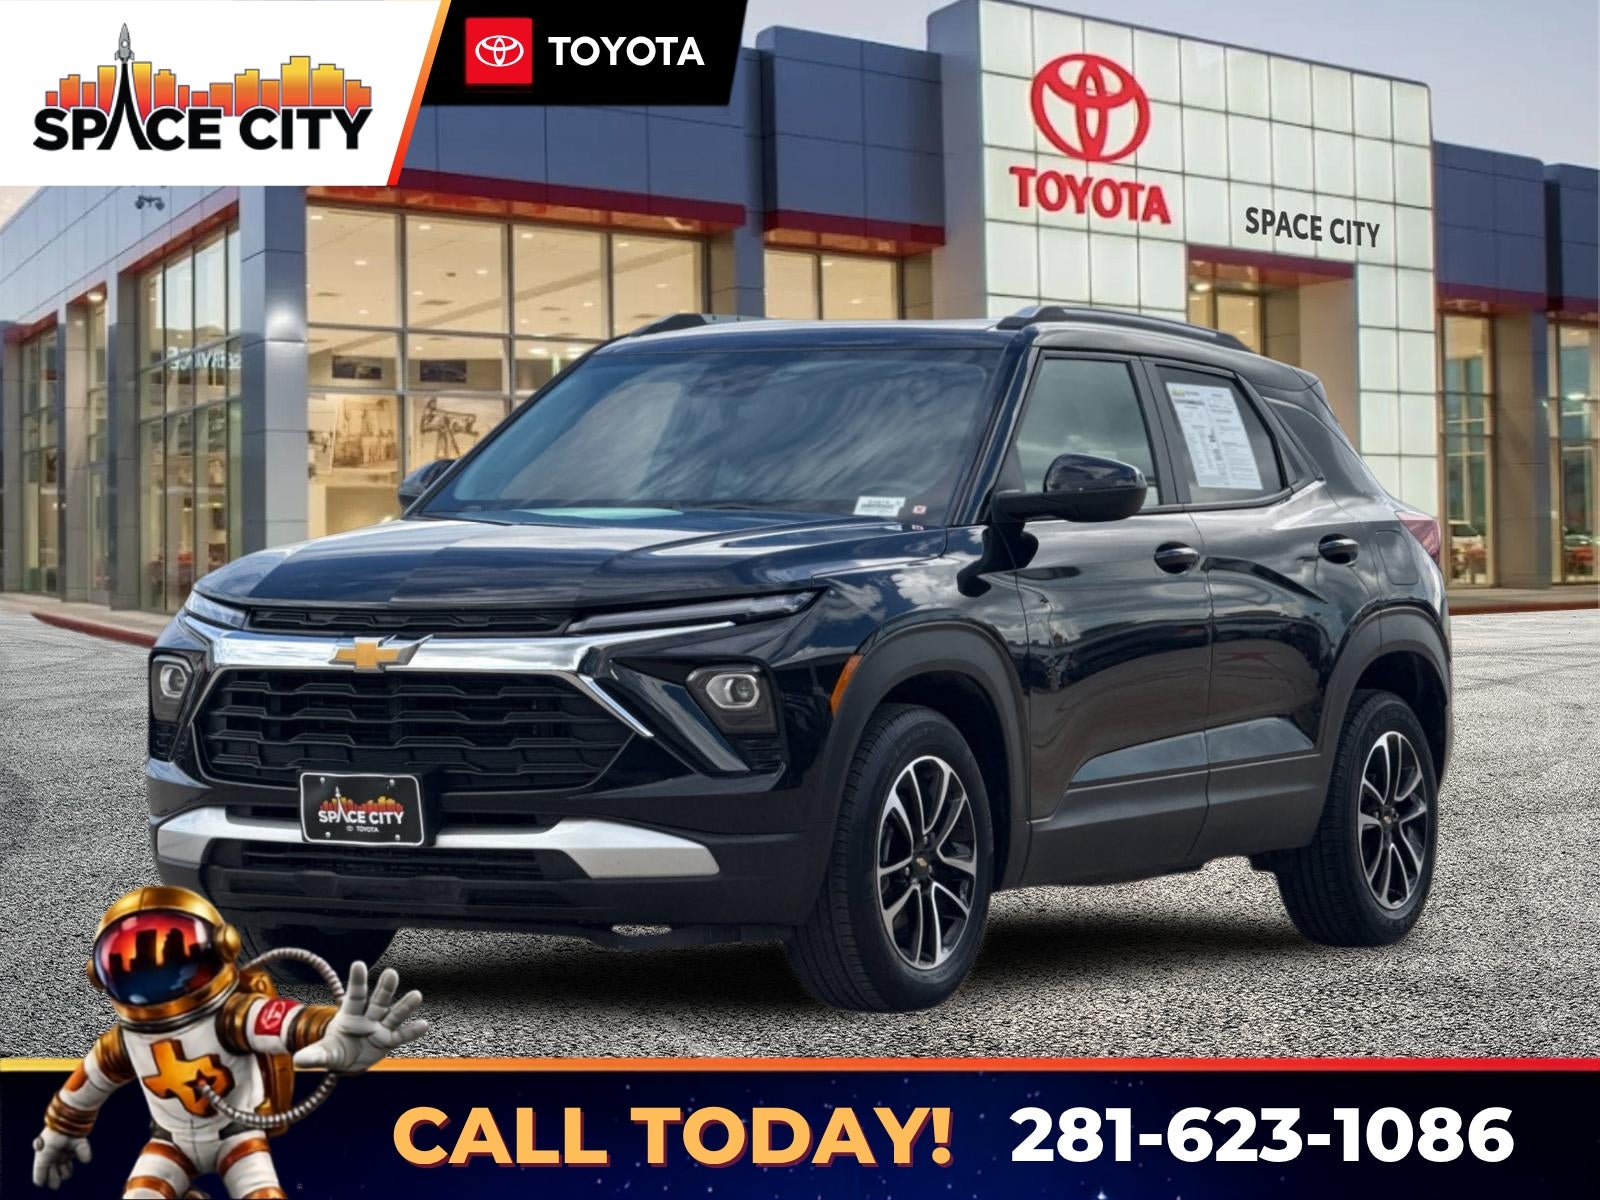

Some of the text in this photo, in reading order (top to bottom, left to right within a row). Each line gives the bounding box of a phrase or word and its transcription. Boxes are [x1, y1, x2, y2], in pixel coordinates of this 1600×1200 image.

[1009, 166, 1171, 224] TOYOTA
[1245, 206, 1380, 248] SPACE CITY
[355, 825, 380, 833] TOYOTA
[368, 811, 404, 825] CITY
